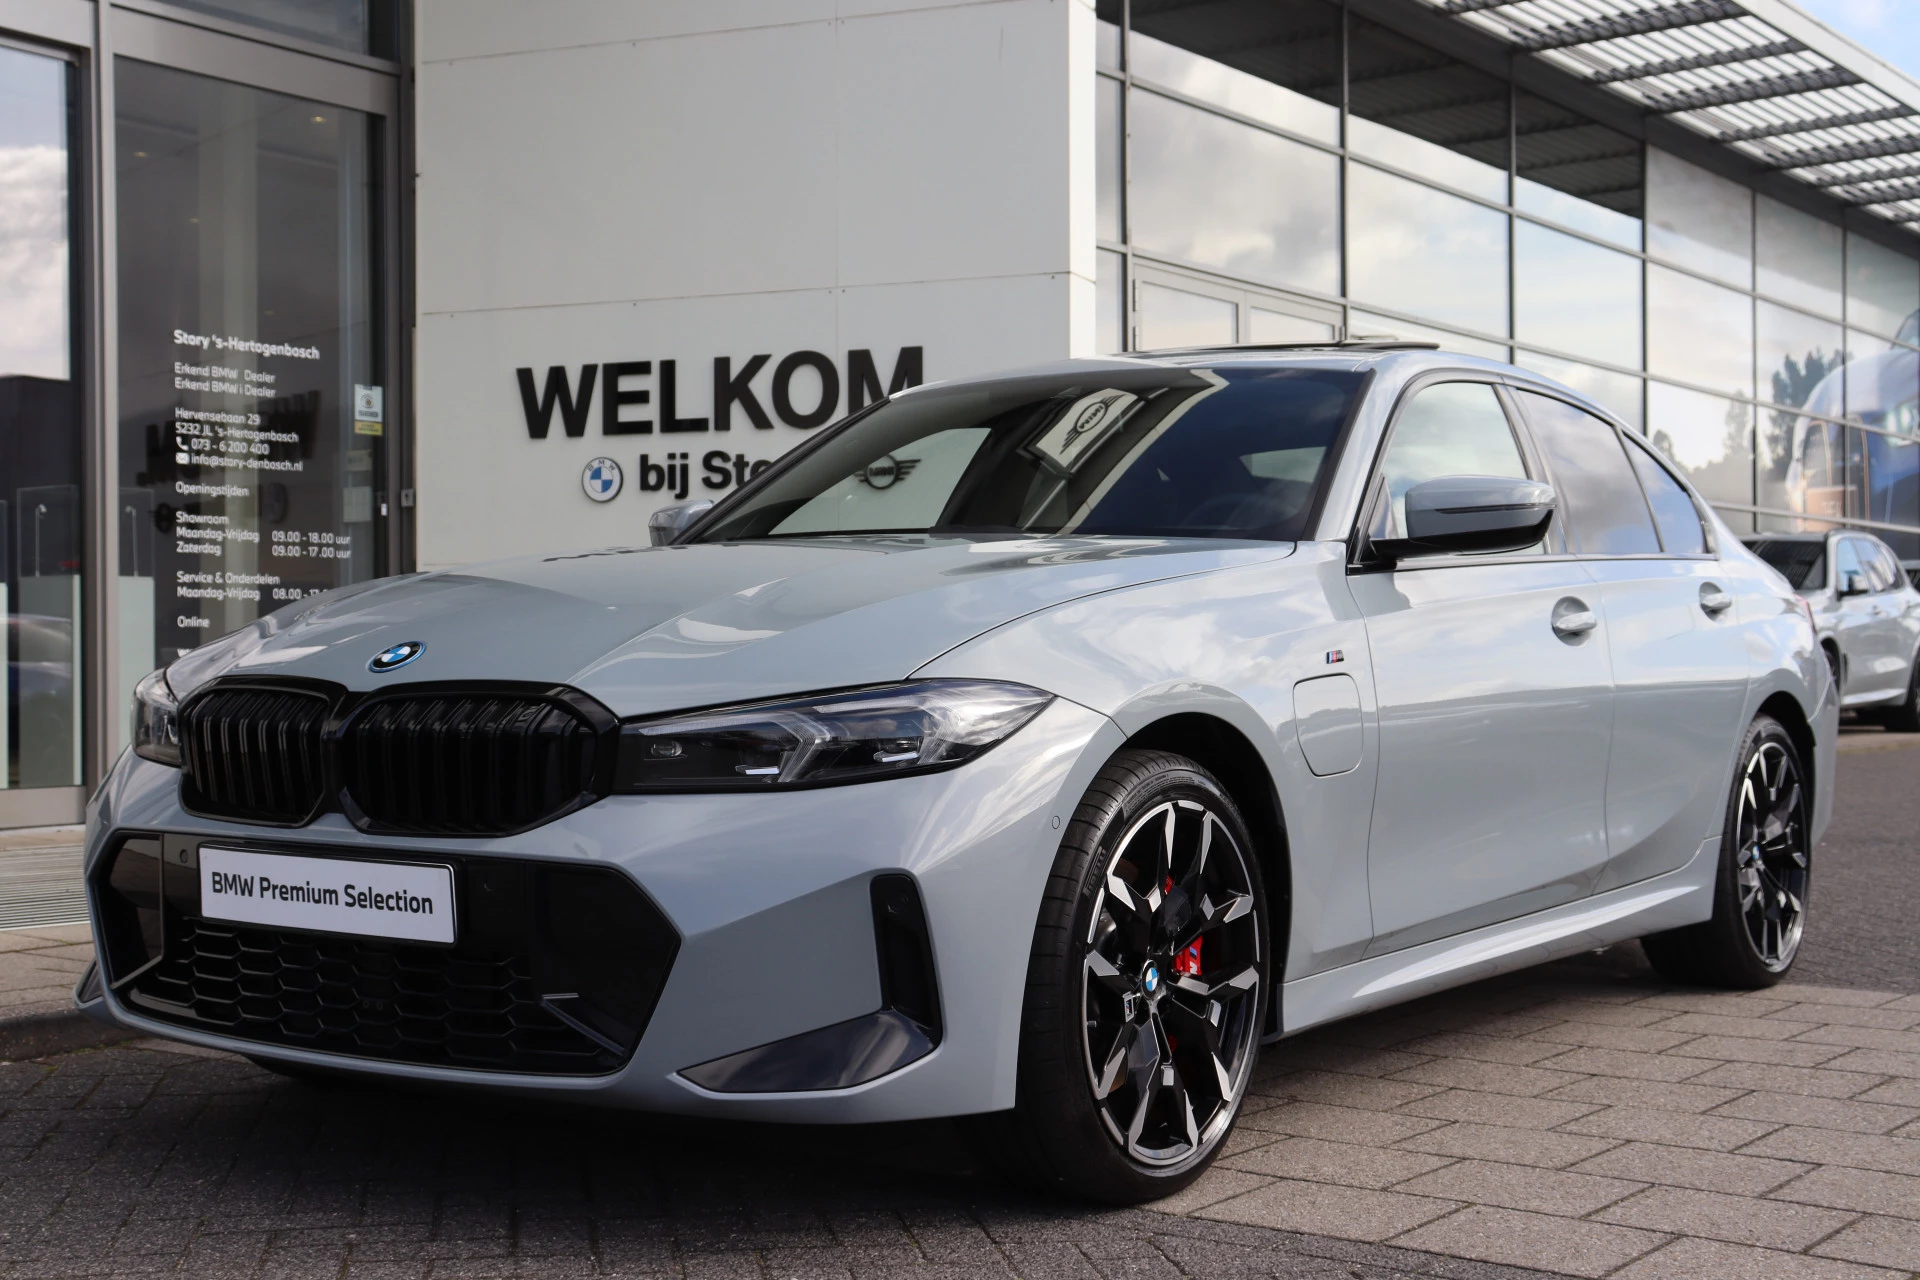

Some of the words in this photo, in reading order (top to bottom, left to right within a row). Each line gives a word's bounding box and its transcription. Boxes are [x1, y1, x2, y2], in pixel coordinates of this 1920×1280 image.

[173, 329, 210, 350] Story
[212, 334, 320, 360] 's-Hertogenbosch
[175, 361, 210, 377] Erkend
[211, 366, 238, 380] BMW
[244, 369, 276, 383] Dealer
[175, 377, 210, 391] Erkend
[211, 381, 238, 395] BMW
[244, 384, 276, 399] Dealer
[516, 346, 923, 440] WELKOM
[175, 407, 246, 424] Hervensebaan
[247, 414, 261, 425] 29
[175, 422, 201, 435] 5232
[202, 424, 214, 437] JL
[215, 426, 300, 443] 's-Hertogenbosch
[191, 438, 211, 451] 073
[249, 443, 270, 455] 400
[191, 453, 304, 471] info@story-denbosch.nl
[640, 453, 689, 499] bij
[175, 481, 250, 497] Openingstijden
[175, 511, 230, 525] Showroom
[176, 526, 260, 544] Maandag-Vrijdag
[271, 530, 301, 543] 09.00
[308, 532, 335, 545] 18.00
[335, 536, 351, 545] uur
[176, 541, 222, 557] Zaterdag
[271, 545, 301, 557] 09.00
[335, 550, 352, 559] uur
[176, 571, 213, 584] Service
[214, 572, 223, 584] &
[224, 572, 280, 585] Onderdelen
[177, 586, 261, 602] Maandag-Vrijdag
[272, 588, 302, 600] 08.00
[177, 615, 210, 628] Online
[212, 871, 254, 897] BMW
[259, 876, 339, 906] Premium
[344, 884, 433, 914] Selection
